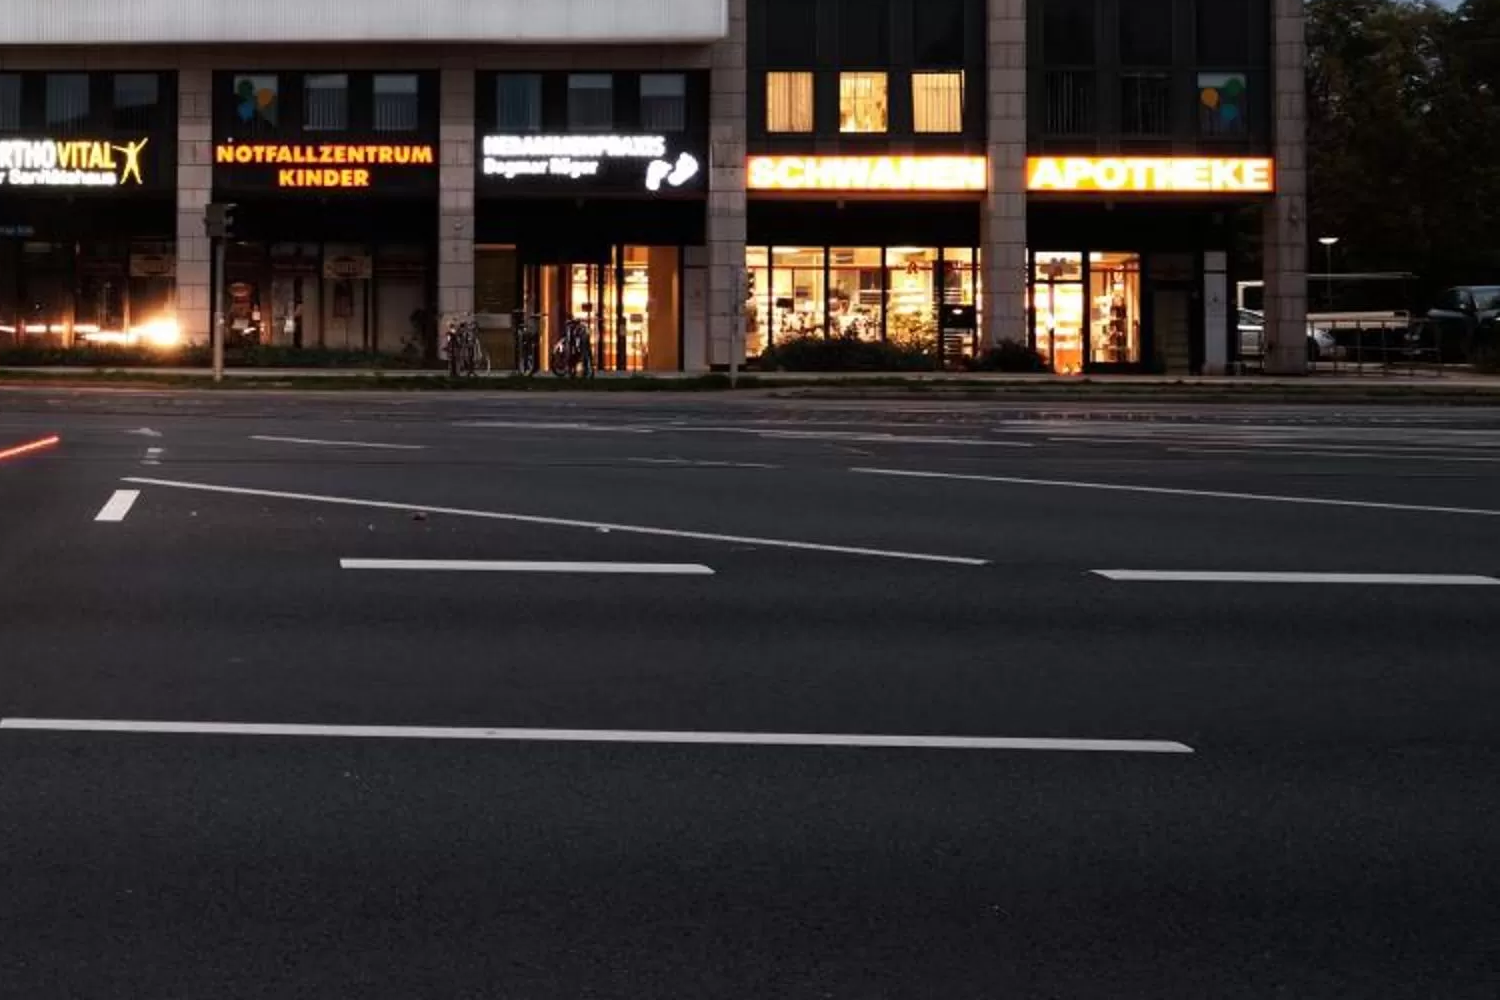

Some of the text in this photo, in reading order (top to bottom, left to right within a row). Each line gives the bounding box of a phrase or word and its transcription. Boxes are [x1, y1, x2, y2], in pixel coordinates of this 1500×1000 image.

[216, 144, 434, 164] NOTFALLZENTRUM
[278, 168, 370, 187] KINDER
[1028, 157, 1269, 190] APOTHEKE
